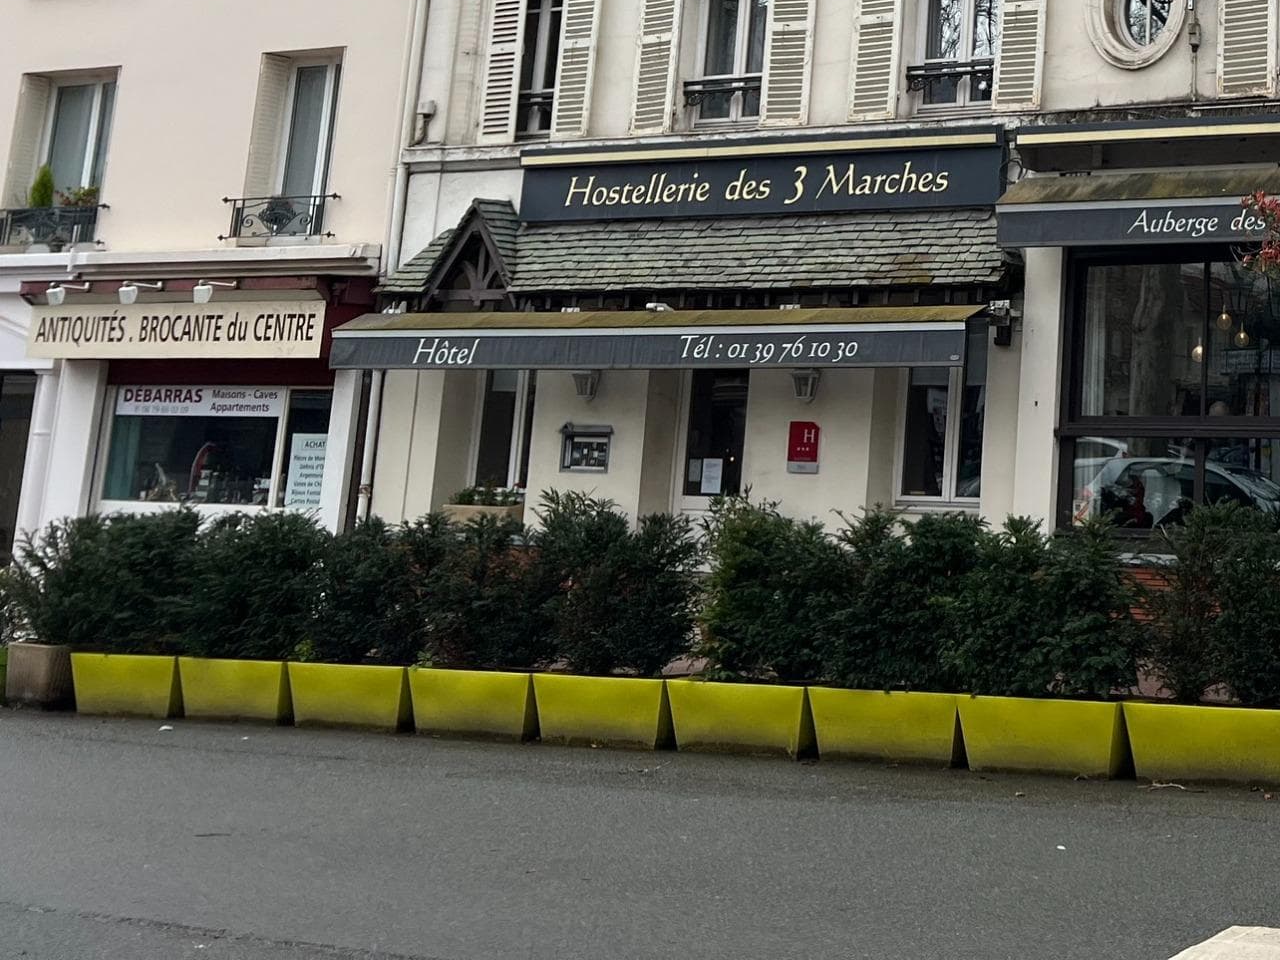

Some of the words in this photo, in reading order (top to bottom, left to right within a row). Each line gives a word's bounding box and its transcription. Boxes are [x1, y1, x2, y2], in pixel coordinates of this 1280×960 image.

[564, 172, 710, 207] Hostellerie
[724, 168, 771, 200] des
[783, 165, 808, 204] 3
[815, 160, 948, 200] Marches
[1126, 209, 1218, 237] Auberge
[1230, 208, 1266, 230] des
[35, 309, 126, 347] ANTIQUITÉS
[139, 315, 223, 342] BROCANTE
[227, 312, 248, 341] du
[254, 313, 316, 342] CENTRE
[412, 338, 480, 364] Hôtel
[750, 343, 774, 363] 39
[778, 335, 806, 363] 76
[832, 341, 858, 362] 30
[212, 389, 246, 399] Maisons
[253, 390, 278, 399] Caves
[210, 402, 270, 414] Appartements
[803, 429, 815, 443] H
